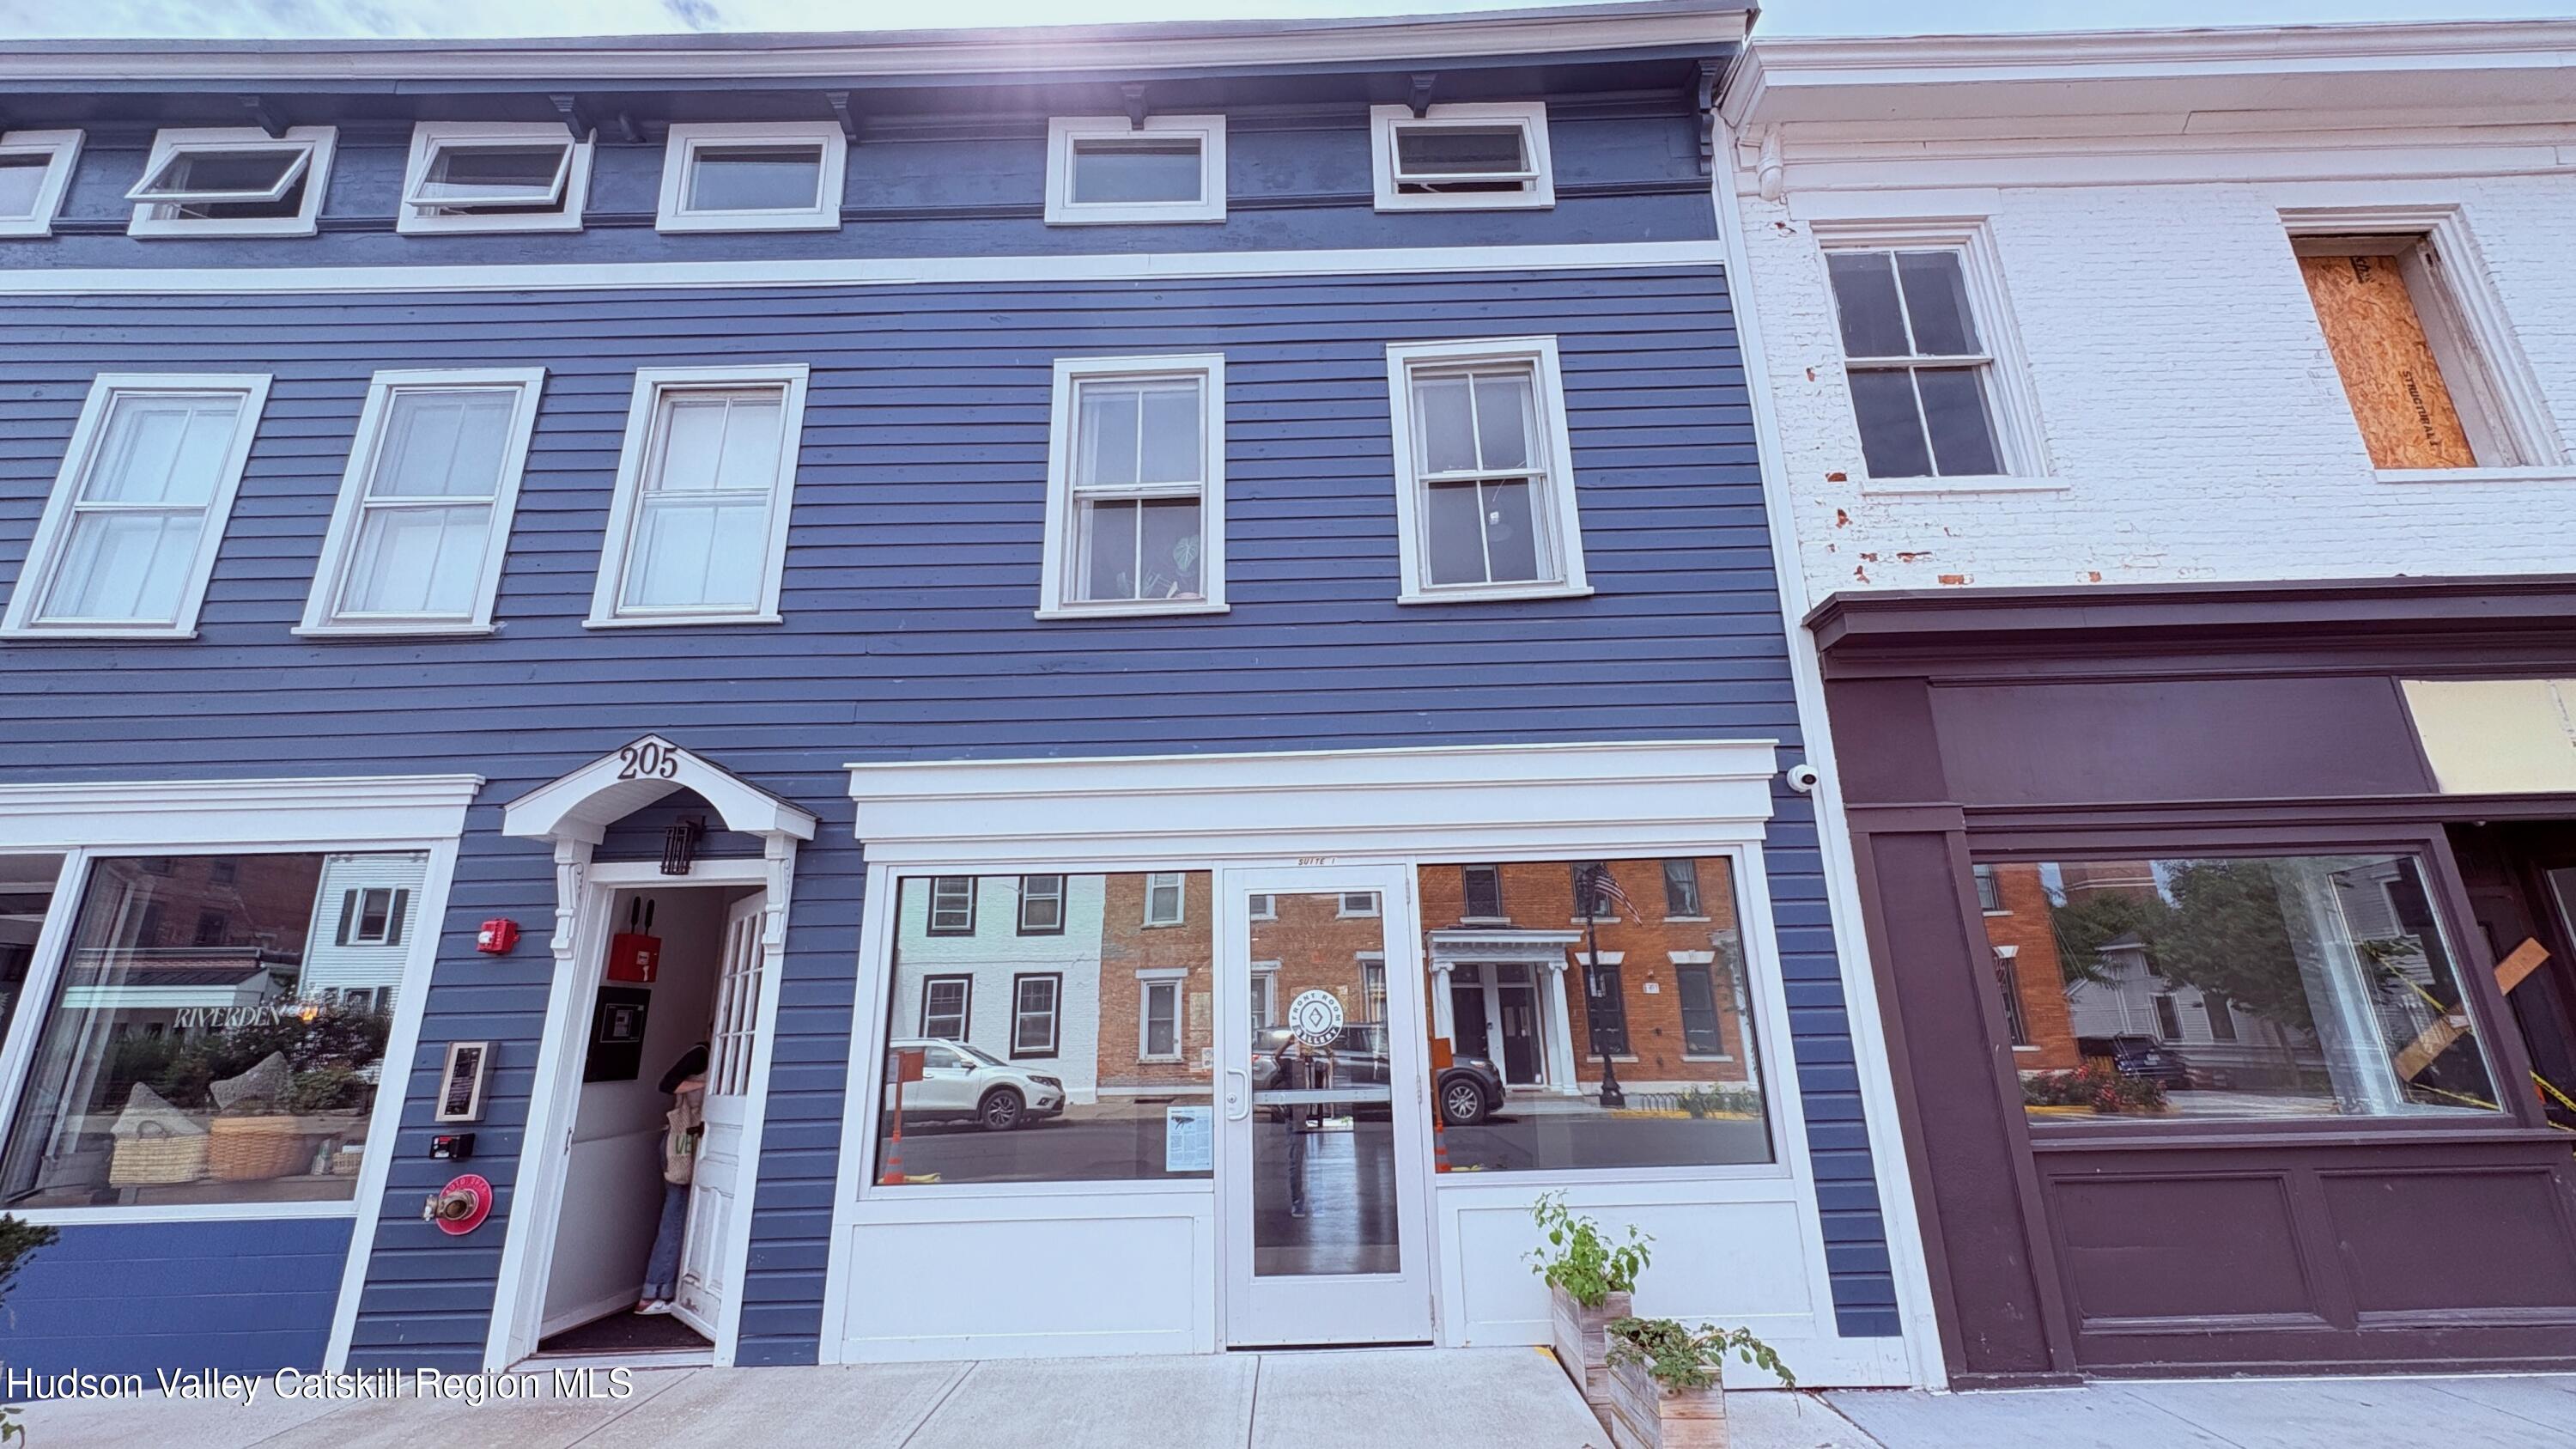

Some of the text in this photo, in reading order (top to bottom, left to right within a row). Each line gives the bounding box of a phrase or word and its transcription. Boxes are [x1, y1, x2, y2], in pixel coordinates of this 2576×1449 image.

[2403, 370, 2435, 440] STRUCTURAL
[617, 741, 677, 779] 205
[1297, 857, 1326, 866] SUITE
[173, 1006, 281, 1028] RIVERDEN
[1291, 992, 1341, 1021] FRONT ROOM
[1295, 1027, 1337, 1044] GALLERY
